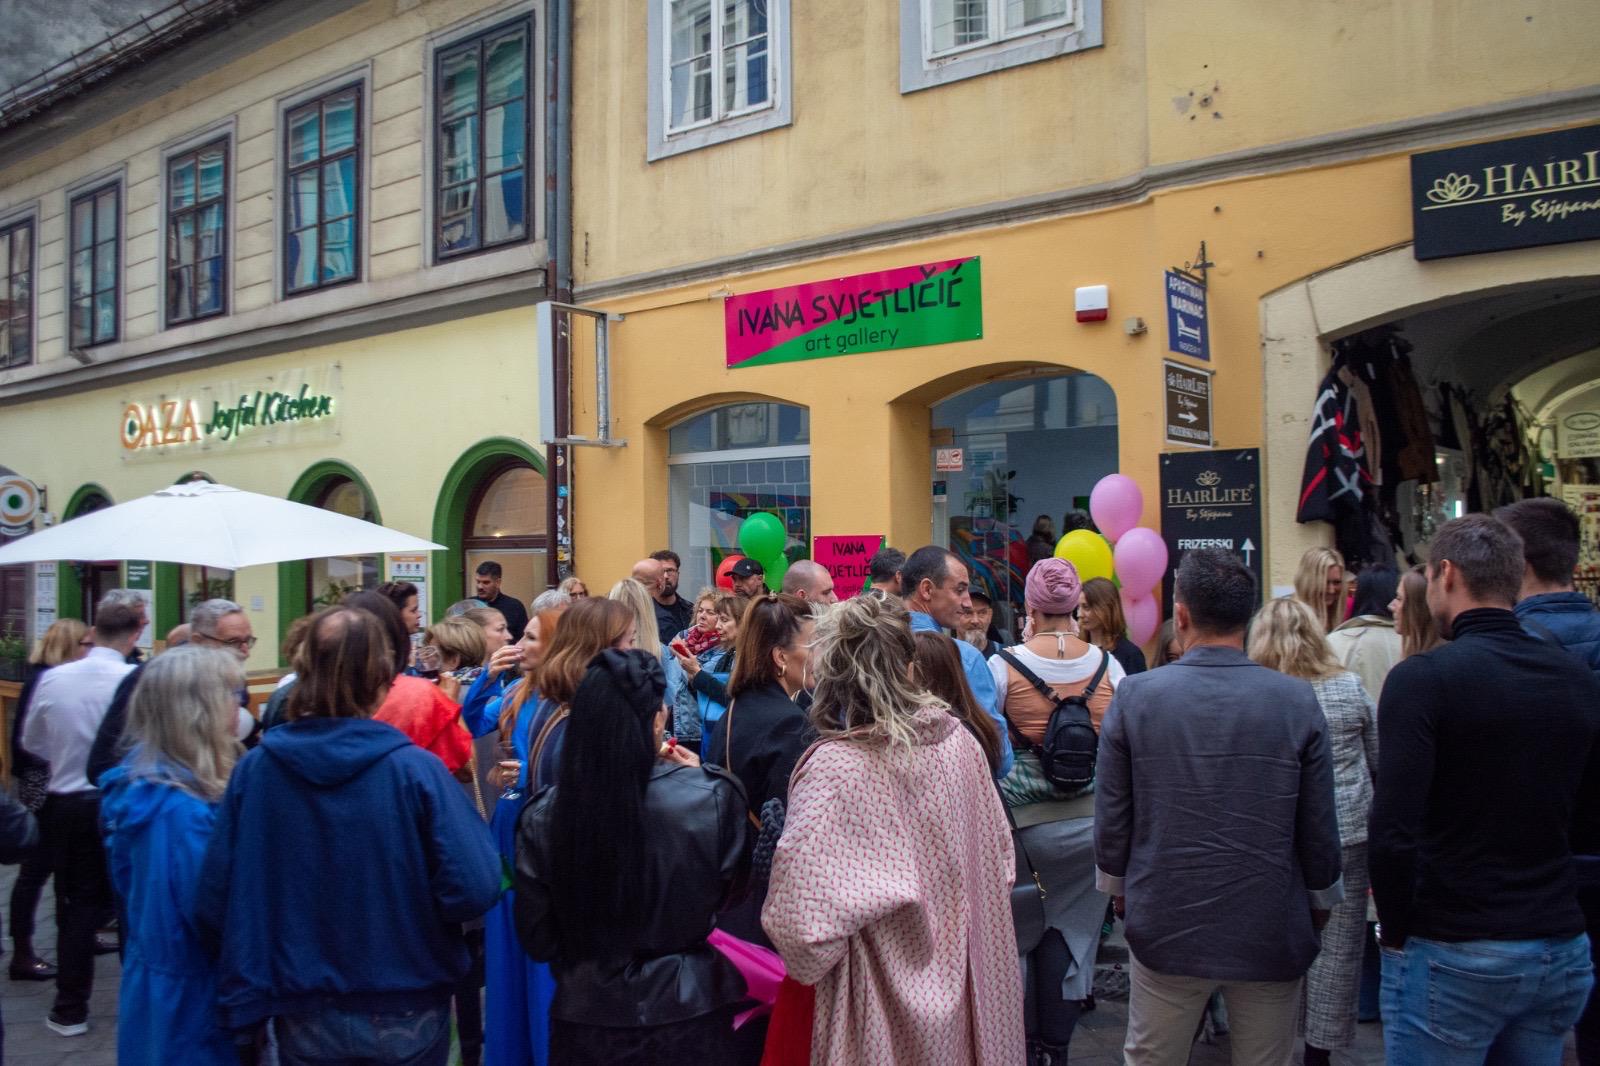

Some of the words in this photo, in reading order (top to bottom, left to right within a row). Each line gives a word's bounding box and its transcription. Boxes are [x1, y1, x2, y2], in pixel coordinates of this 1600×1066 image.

[1500, 203, 1527, 227] By
[738, 298, 805, 337] IVANA
[812, 262, 963, 325] SVJETLIČIĆ
[805, 333, 831, 352] art
[836, 326, 900, 353] gallery
[120, 398, 202, 450] OAZA
[205, 390, 262, 441] Joyful
[262, 383, 332, 426] Kitchen
[832, 542, 866, 556] IVANA
[1177, 538, 1234, 550] FRIZERSKI
